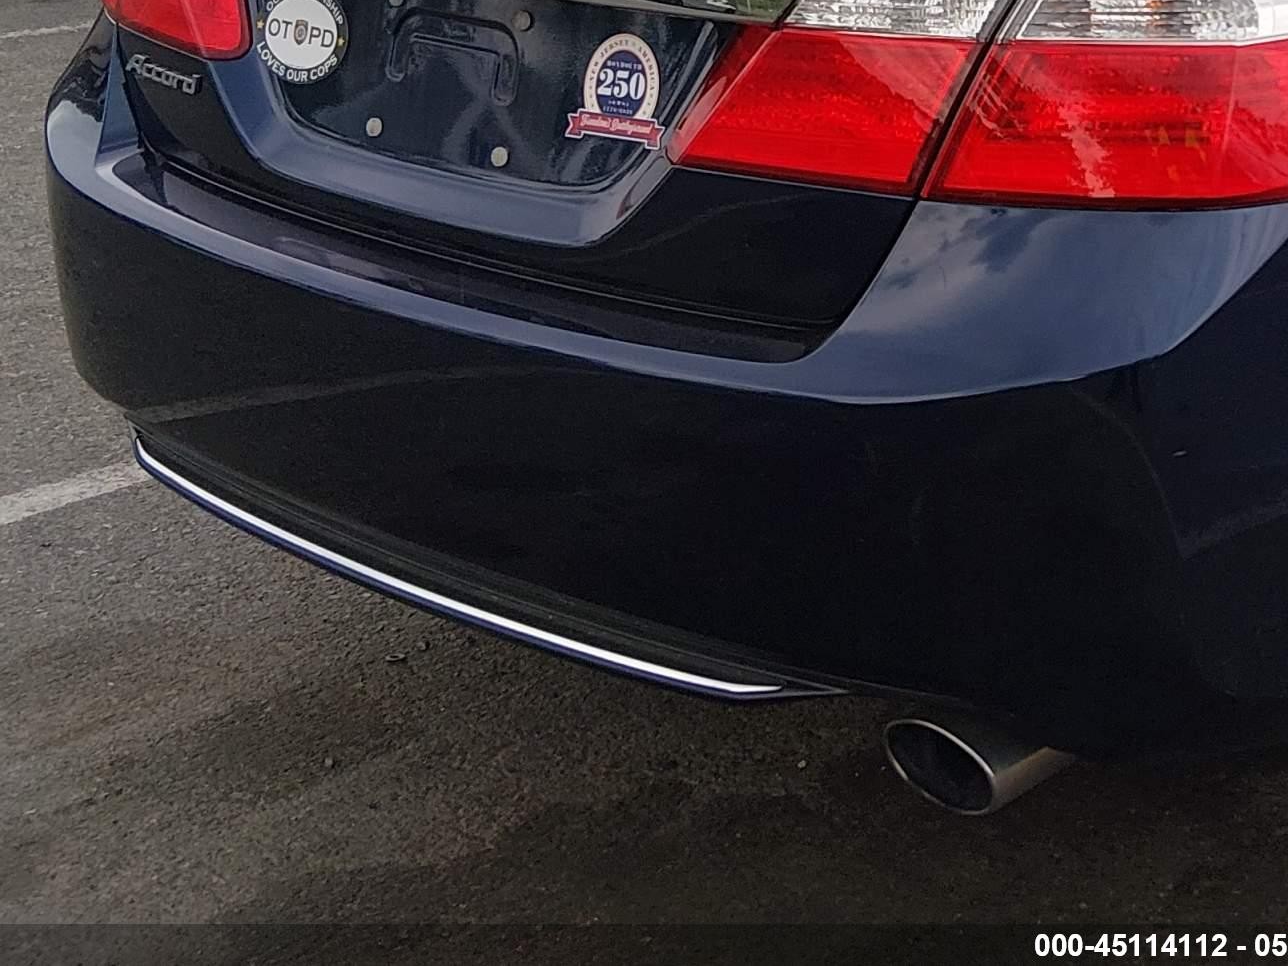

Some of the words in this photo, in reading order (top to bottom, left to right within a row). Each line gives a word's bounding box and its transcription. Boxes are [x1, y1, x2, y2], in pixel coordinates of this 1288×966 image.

[268, 18, 293, 39] OT
[307, 26, 335, 48] PD
[125, 54, 202, 95] Accord
[256, 41, 286, 76] LOVES
[286, 69, 308, 83] OUR
[310, 54, 338, 80] COPS
[597, 68, 646, 101] 250
